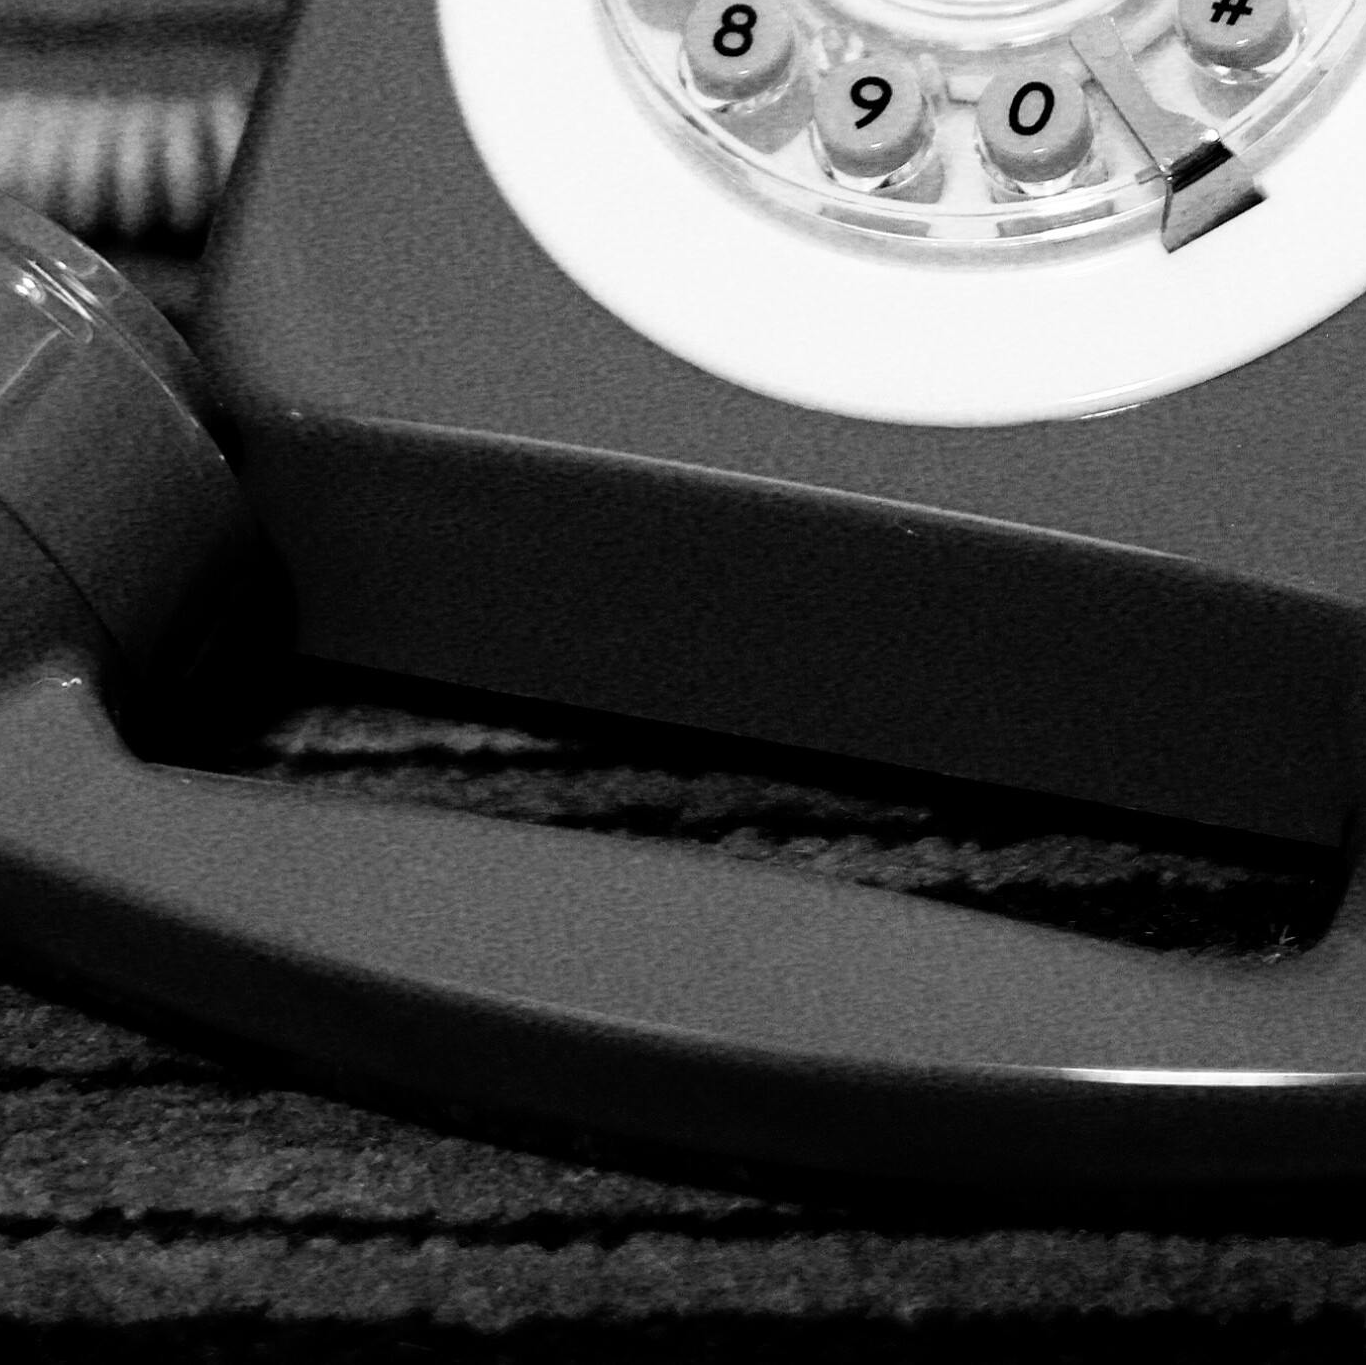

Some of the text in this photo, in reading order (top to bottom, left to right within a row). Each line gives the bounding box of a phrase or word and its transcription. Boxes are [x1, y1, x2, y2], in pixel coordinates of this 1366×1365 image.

[711, 2, 759, 59] 8
[848, 74, 894, 131] 9
[1007, 80, 1057, 138] 0
